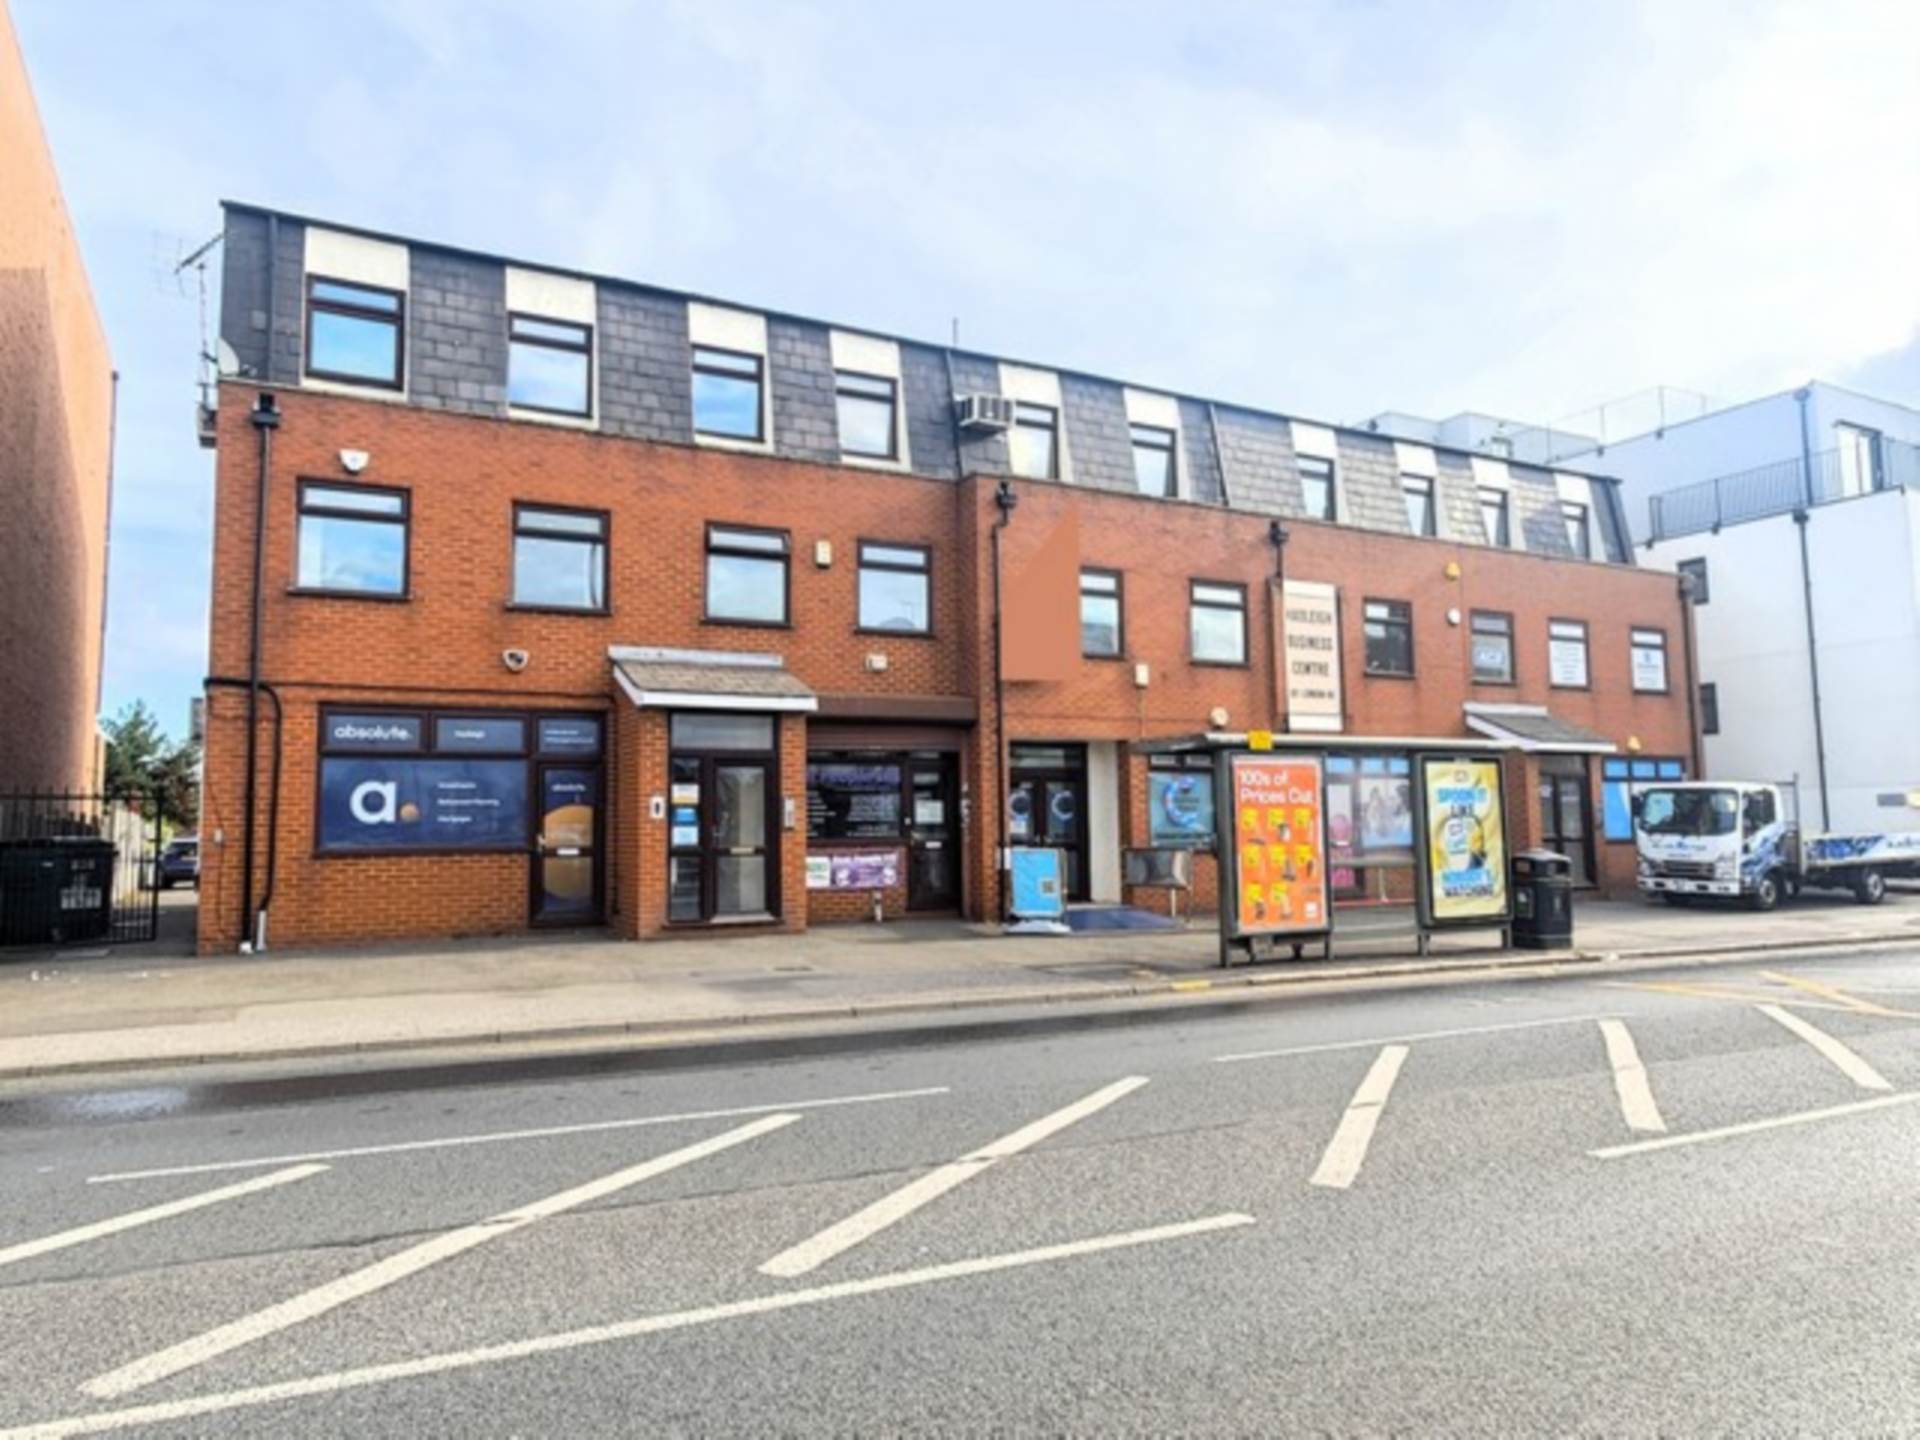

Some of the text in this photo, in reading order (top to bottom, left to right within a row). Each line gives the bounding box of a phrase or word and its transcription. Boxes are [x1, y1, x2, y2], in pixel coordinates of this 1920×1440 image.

[1287, 635, 1333, 650] BUSINESS
[1291, 661, 1330, 676] CENTRE
[1273, 770, 1288, 785] of
[1241, 786, 1314, 803] Prices Cut
